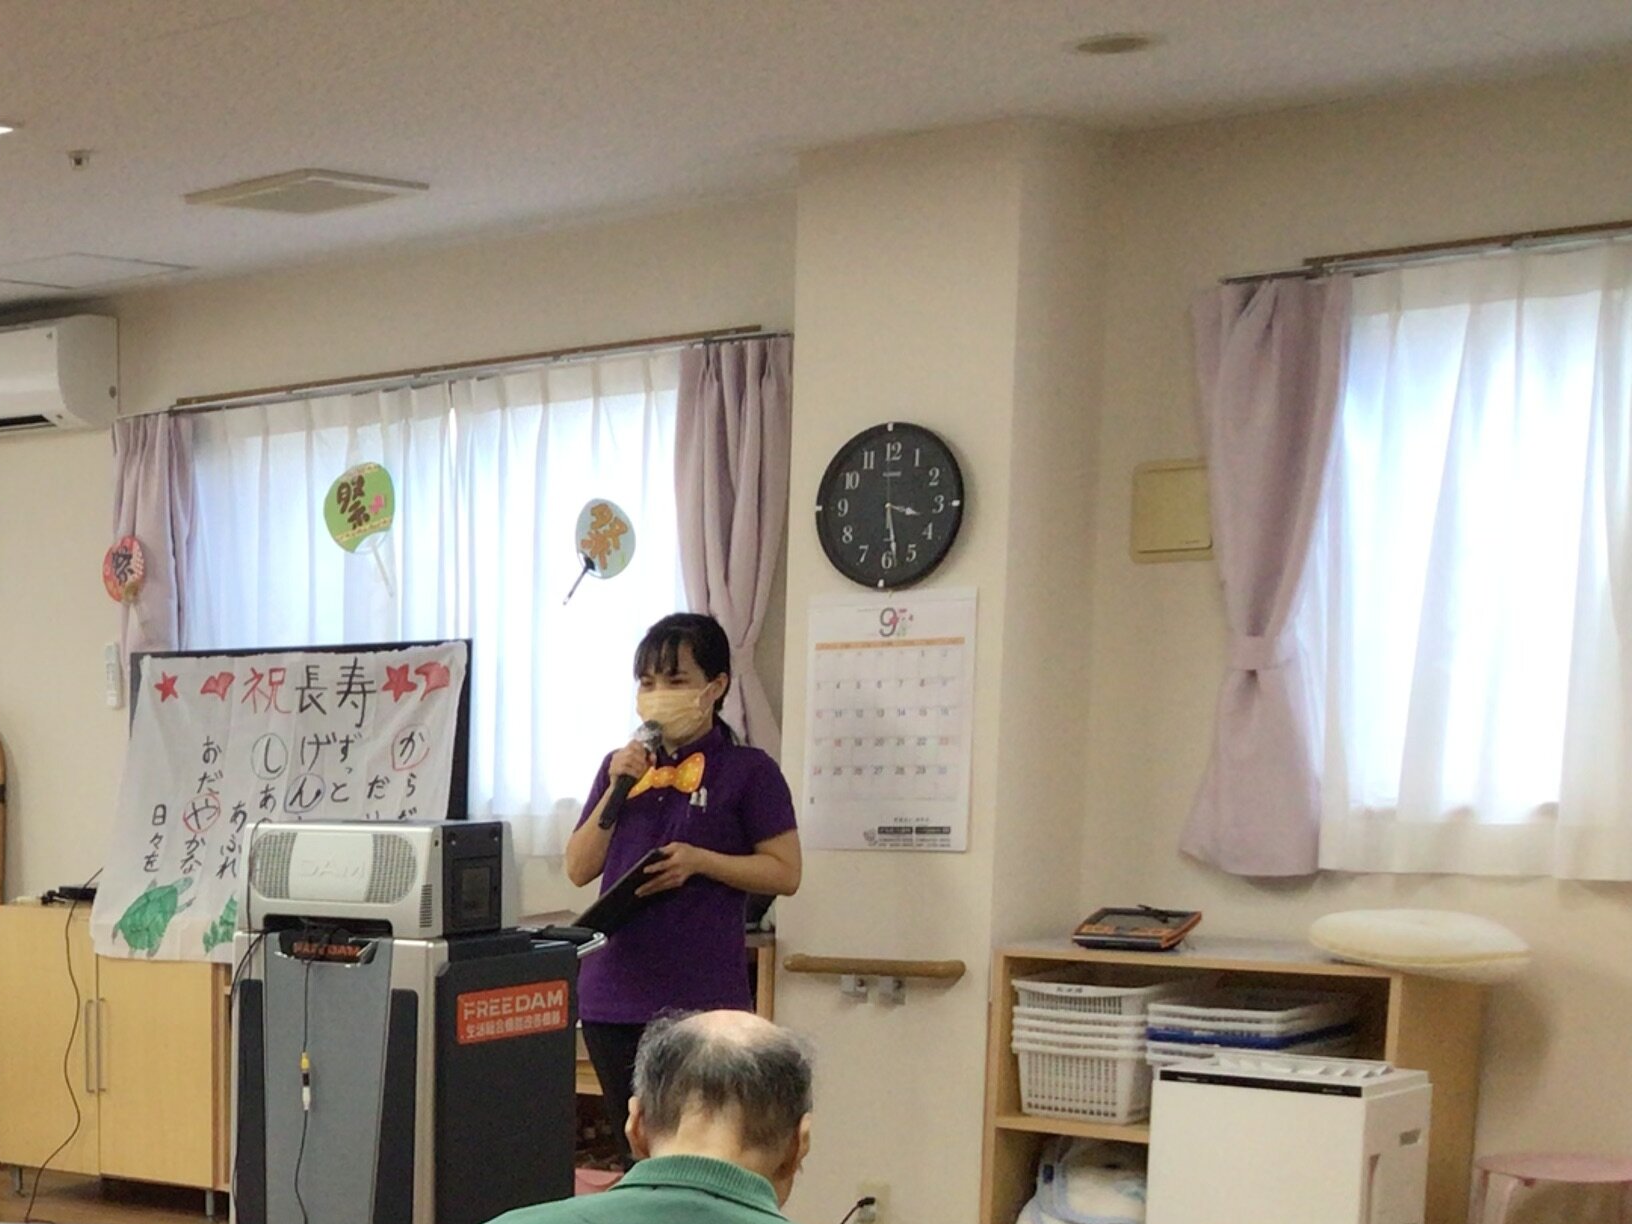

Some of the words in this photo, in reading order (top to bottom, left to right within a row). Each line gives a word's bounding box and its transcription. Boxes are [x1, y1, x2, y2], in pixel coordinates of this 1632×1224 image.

[863, 451, 875, 470] 11
[885, 441, 902, 462] 12
[914, 448, 921, 467] 1
[845, 471, 860, 490] 10
[928, 467, 940, 486] 2
[837, 498, 849, 517] 9
[932, 494, 945, 514] 3
[842, 525, 853, 543] 8
[922, 522, 933, 540] 4
[858, 545, 869, 563] 7
[881, 551, 893, 569] 6
[906, 544, 917, 562] 5
[879, 607, 898, 638] 9
[240, 656, 377, 729] 祝長寿
[288, 731, 337, 820] げん
[398, 730, 426, 820] から
